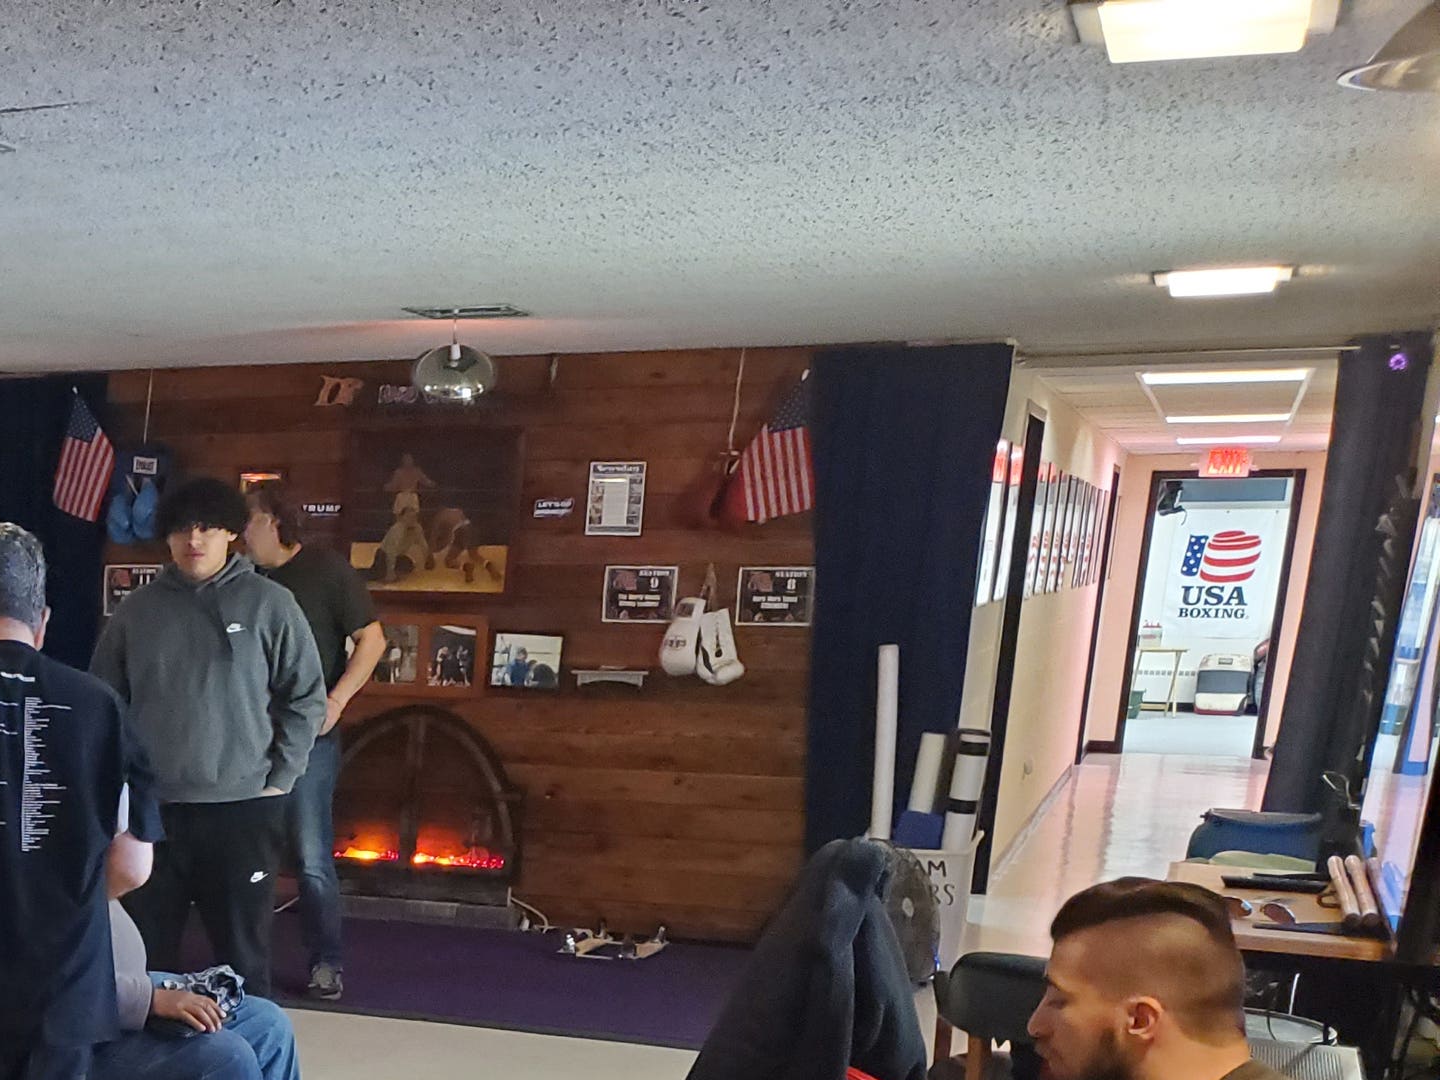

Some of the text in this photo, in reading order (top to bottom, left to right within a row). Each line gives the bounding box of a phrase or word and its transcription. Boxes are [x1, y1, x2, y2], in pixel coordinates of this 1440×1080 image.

[302, 504, 342, 513] TRUMP
[1181, 586, 1247, 606] USA
[1177, 607, 1245, 619] BOXING
